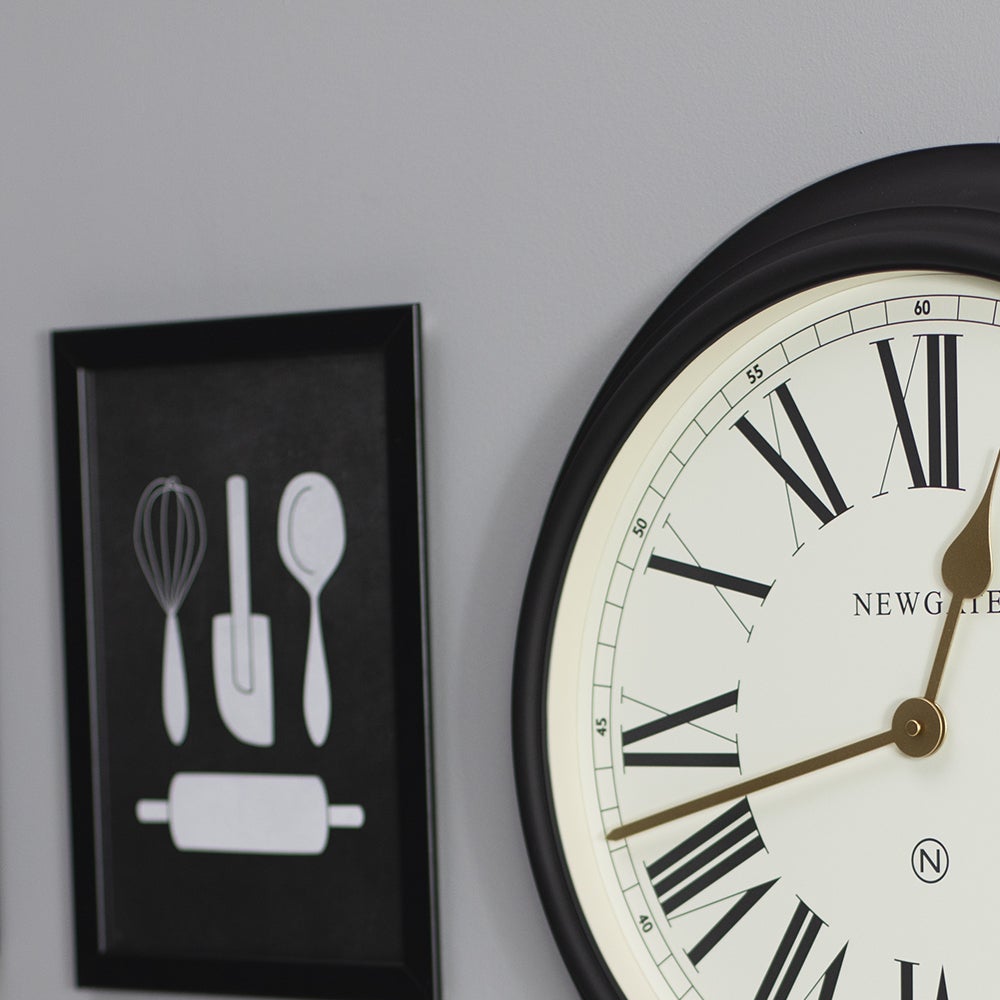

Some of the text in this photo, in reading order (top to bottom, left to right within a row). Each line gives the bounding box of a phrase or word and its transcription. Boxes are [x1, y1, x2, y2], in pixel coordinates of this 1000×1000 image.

[914, 300, 931, 316] 60
[746, 364, 764, 385] 55
[869, 334, 966, 498] XII
[729, 378, 854, 556] XI
[632, 518, 648, 538] 50
[643, 513, 776, 642] X
[595, 717, 607, 736] 45
[621, 680, 742, 775] IX
[920, 848, 940, 873] N
[638, 914, 653, 934] 40
